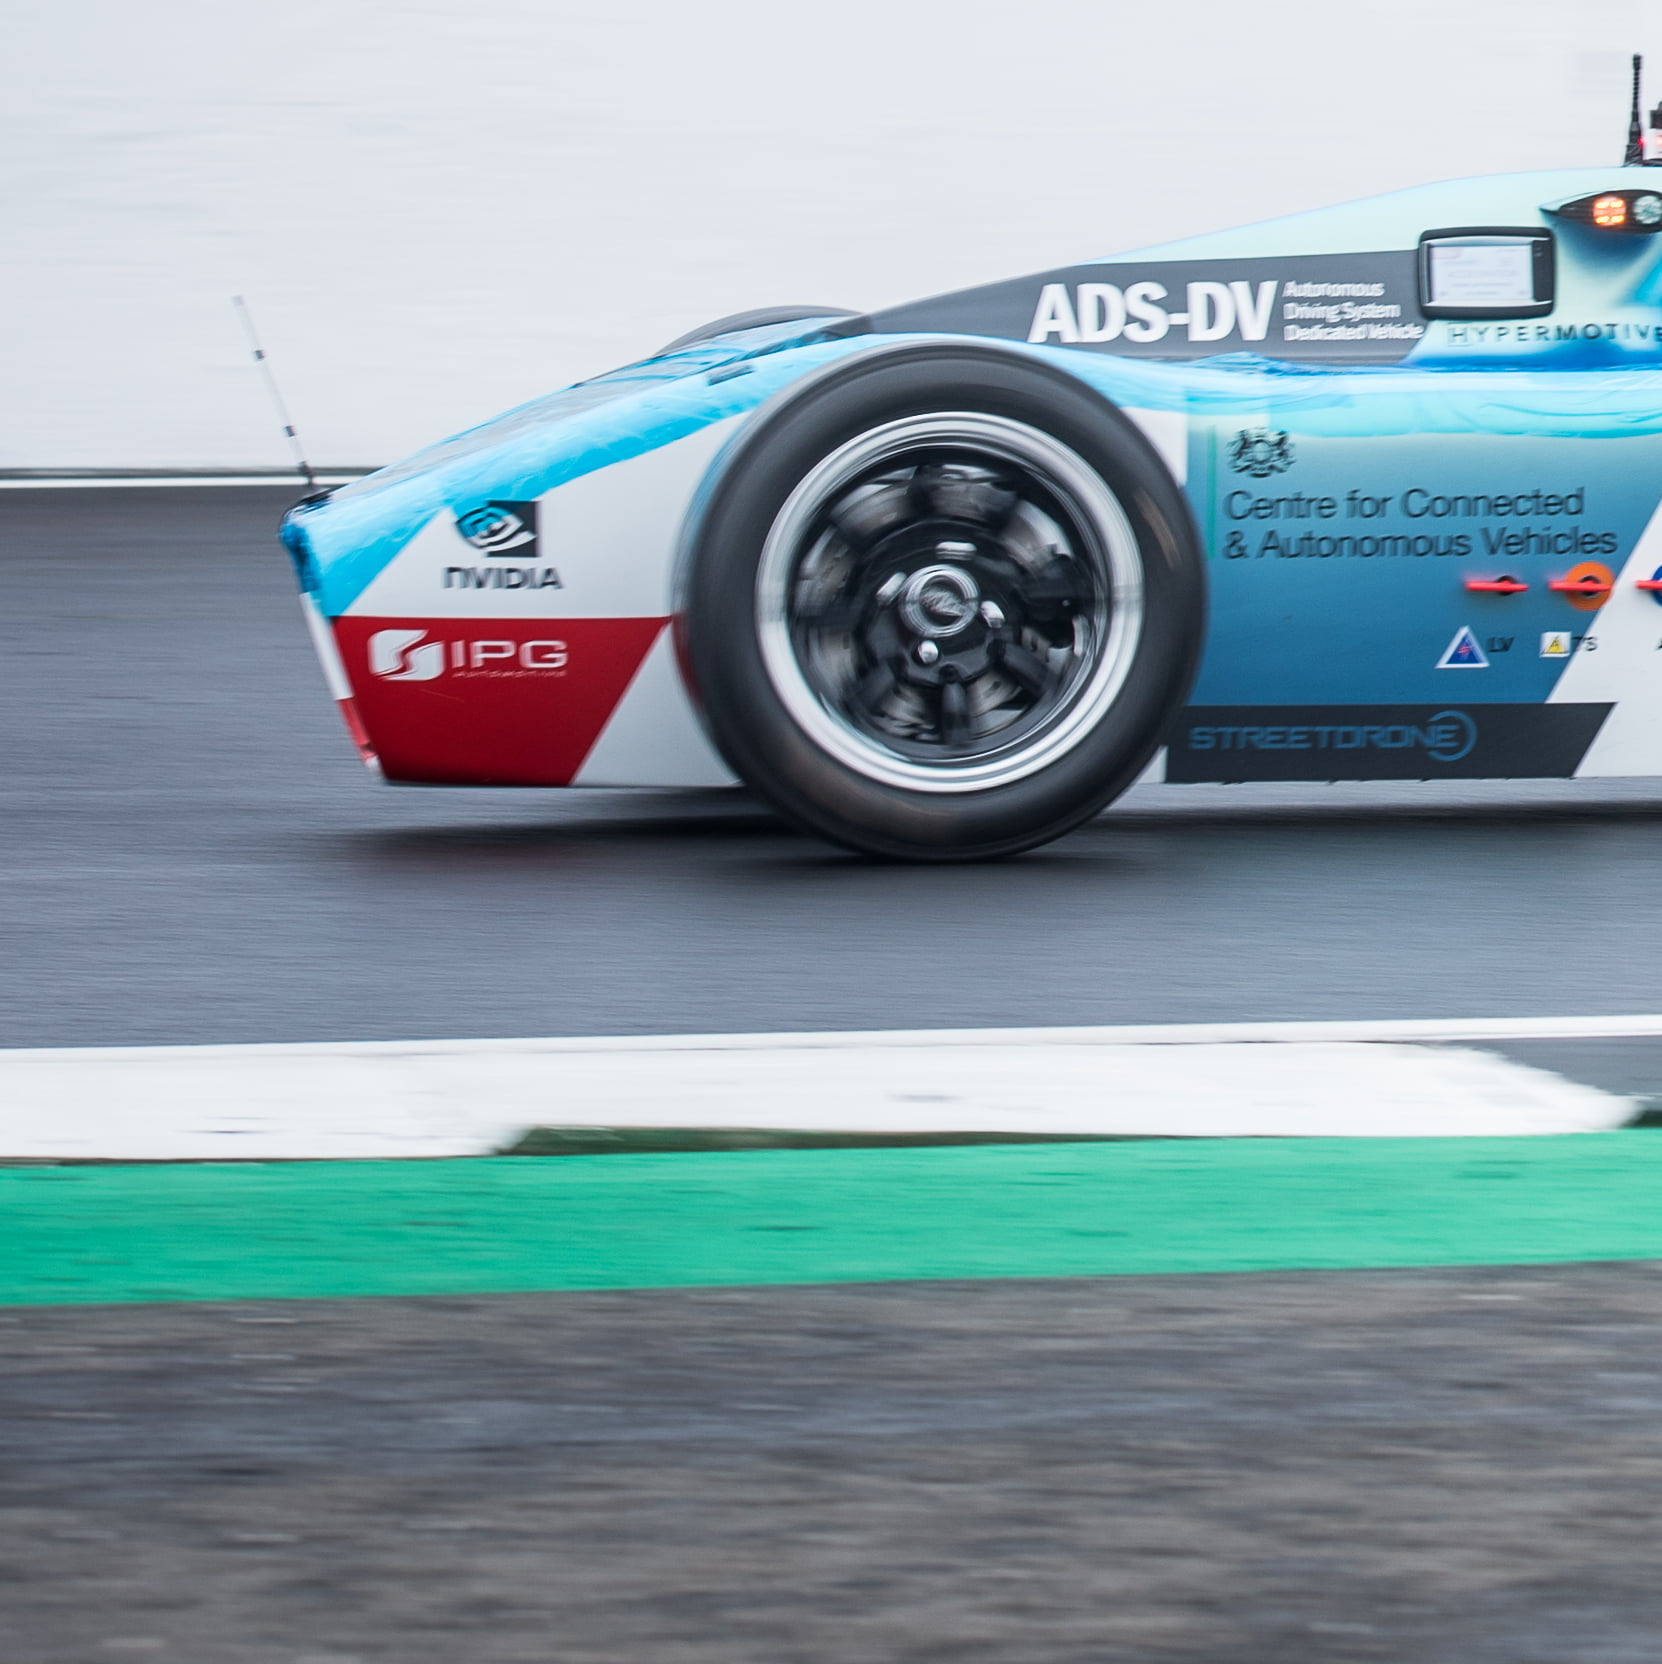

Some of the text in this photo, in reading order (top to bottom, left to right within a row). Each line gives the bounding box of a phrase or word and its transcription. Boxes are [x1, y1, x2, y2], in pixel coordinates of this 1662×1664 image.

[1282, 281, 1386, 297] Autonomous
[1027, 280, 1279, 343] ADS-DV
[1283, 301, 1401, 323] Driving System
[1283, 322, 1425, 341] Dedicated Vehicle
[1224, 487, 1585, 520] Centre for Connected
[1223, 525, 1619, 559] & Autonomous Vehicles
[451, 640, 569, 669] IPG
[1487, 637, 1515, 653] LV
[1189, 725, 1460, 750] STREETDRONE
